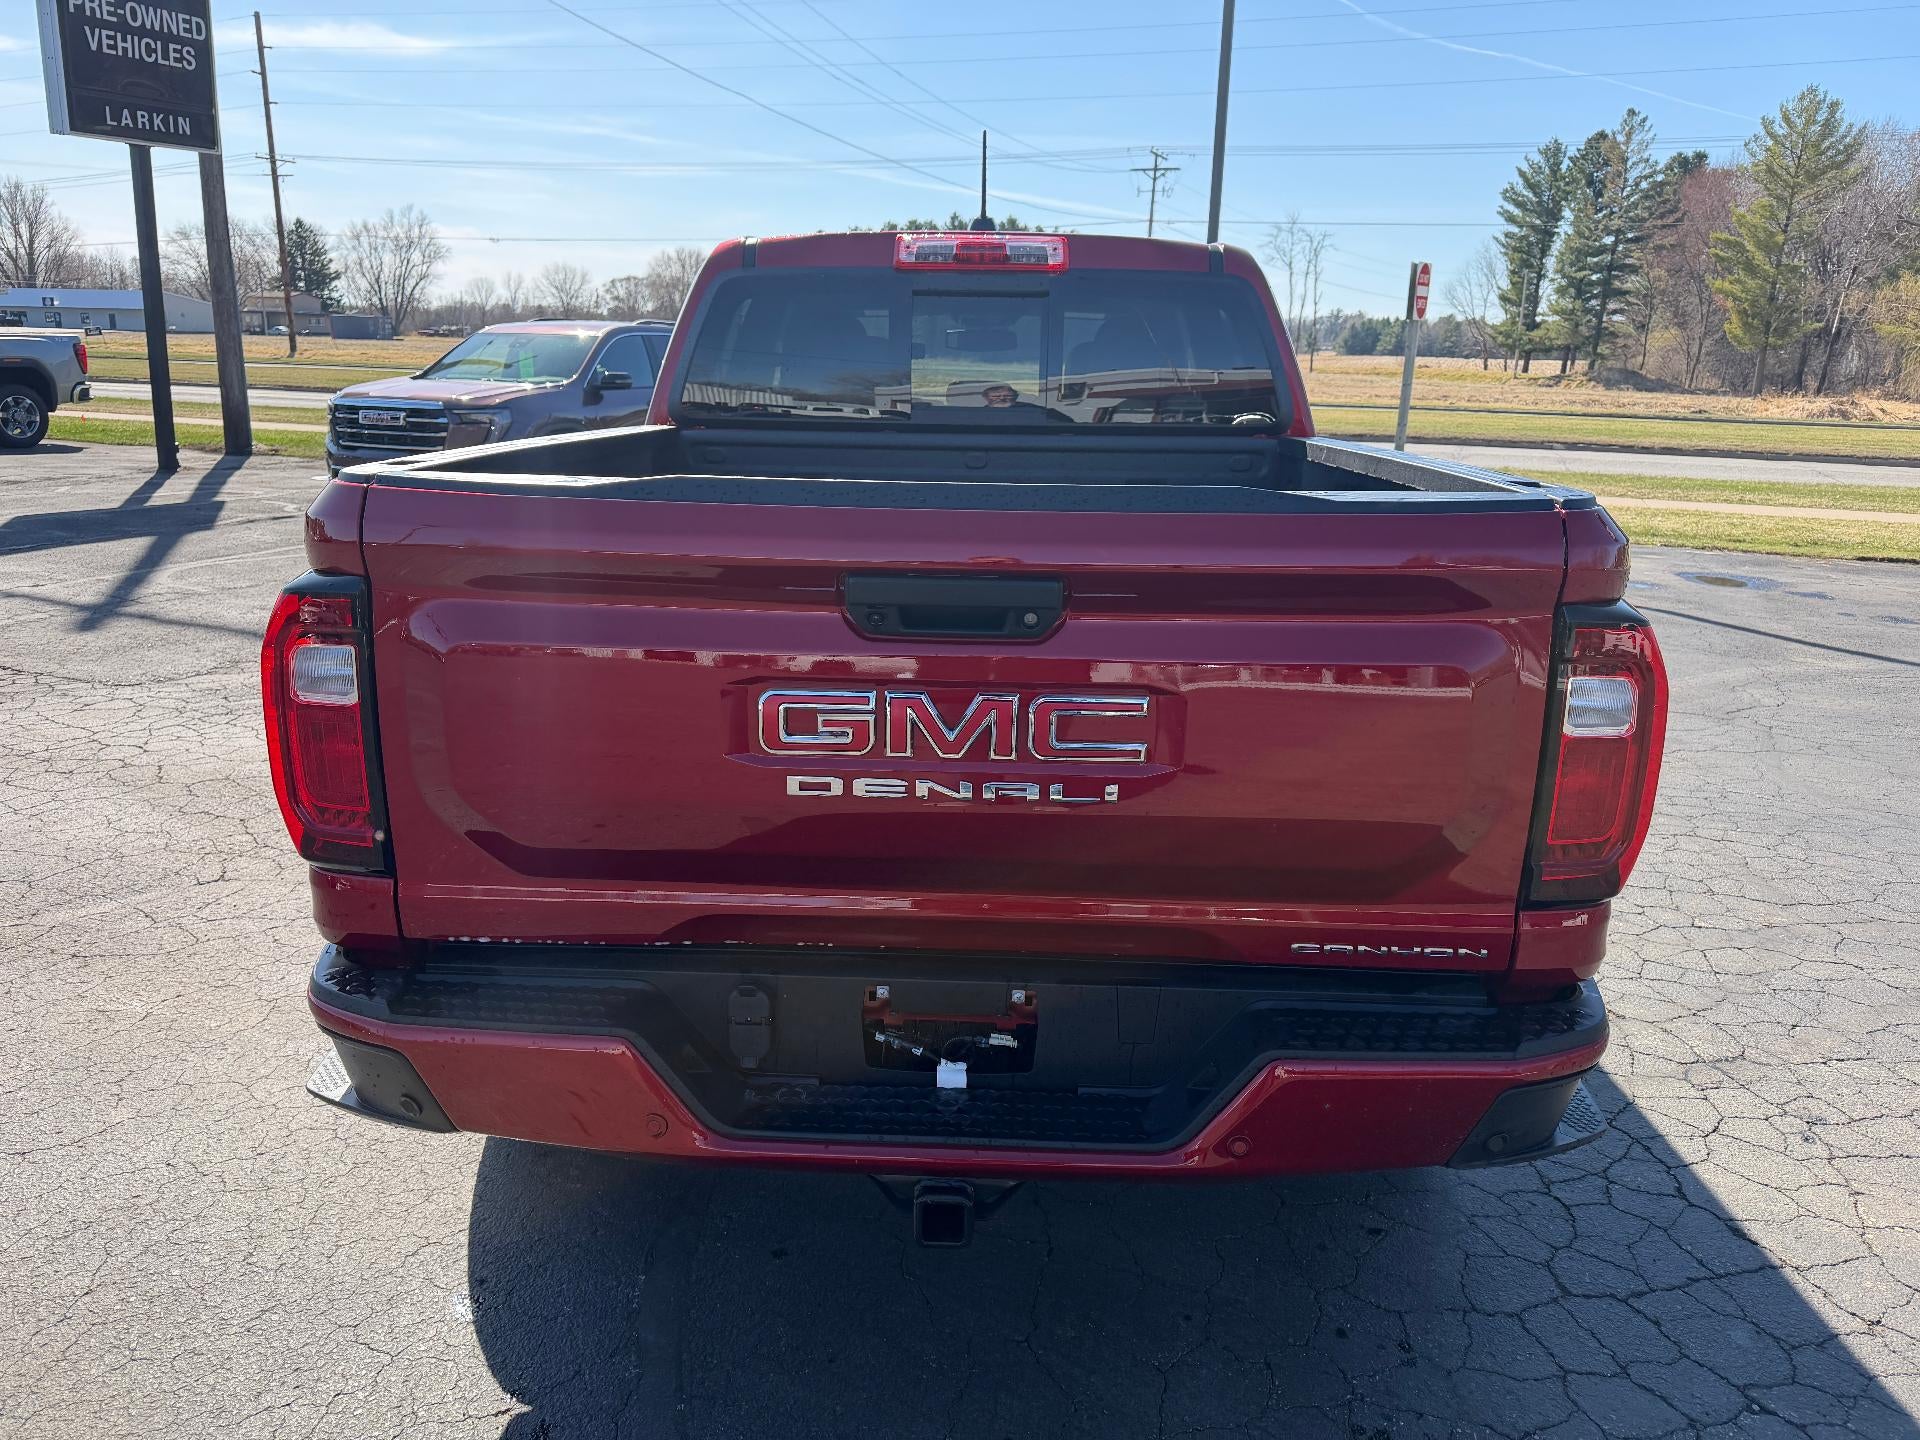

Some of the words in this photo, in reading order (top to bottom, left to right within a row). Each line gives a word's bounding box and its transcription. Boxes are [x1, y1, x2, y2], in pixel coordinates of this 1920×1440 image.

[84, 25, 197, 71] VEHICLES
[105, 105, 191, 136] LARKIN
[758, 689, 1150, 764] GMC
[786, 775, 1119, 803] DENALI
[1290, 942, 1488, 958] CANYON
